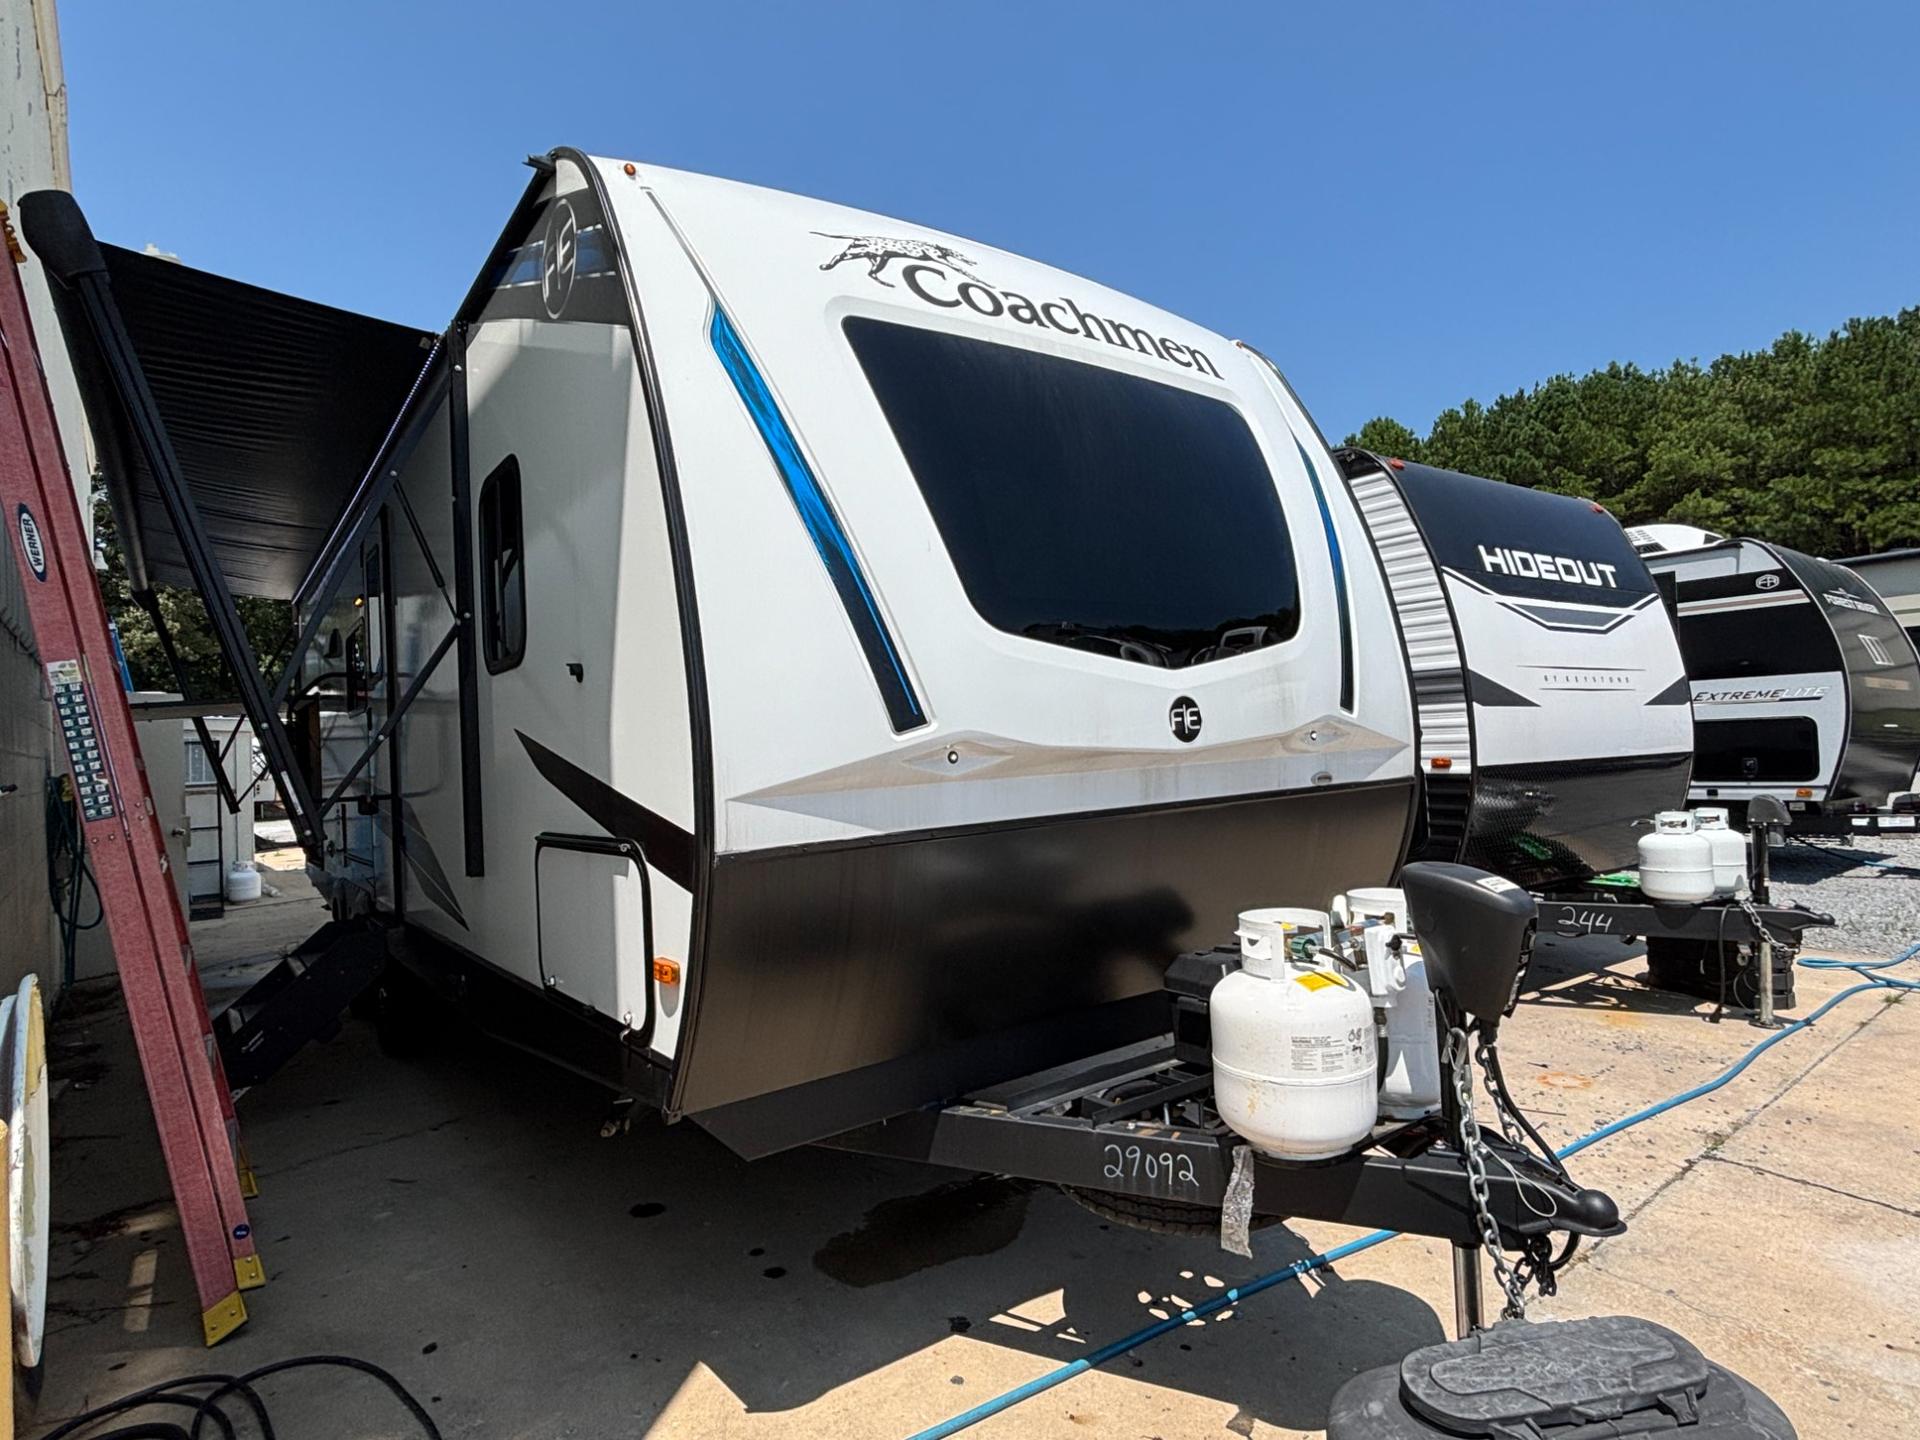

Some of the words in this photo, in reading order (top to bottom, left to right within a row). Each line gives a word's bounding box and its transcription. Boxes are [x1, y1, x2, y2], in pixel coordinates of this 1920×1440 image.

[902, 264, 1225, 380] Coachmen
[22, 518, 43, 567] WERNER
[1477, 544, 1617, 589] HIDEOUT
[1557, 905, 1613, 934] 244
[1103, 1143, 1200, 1187] 29092
